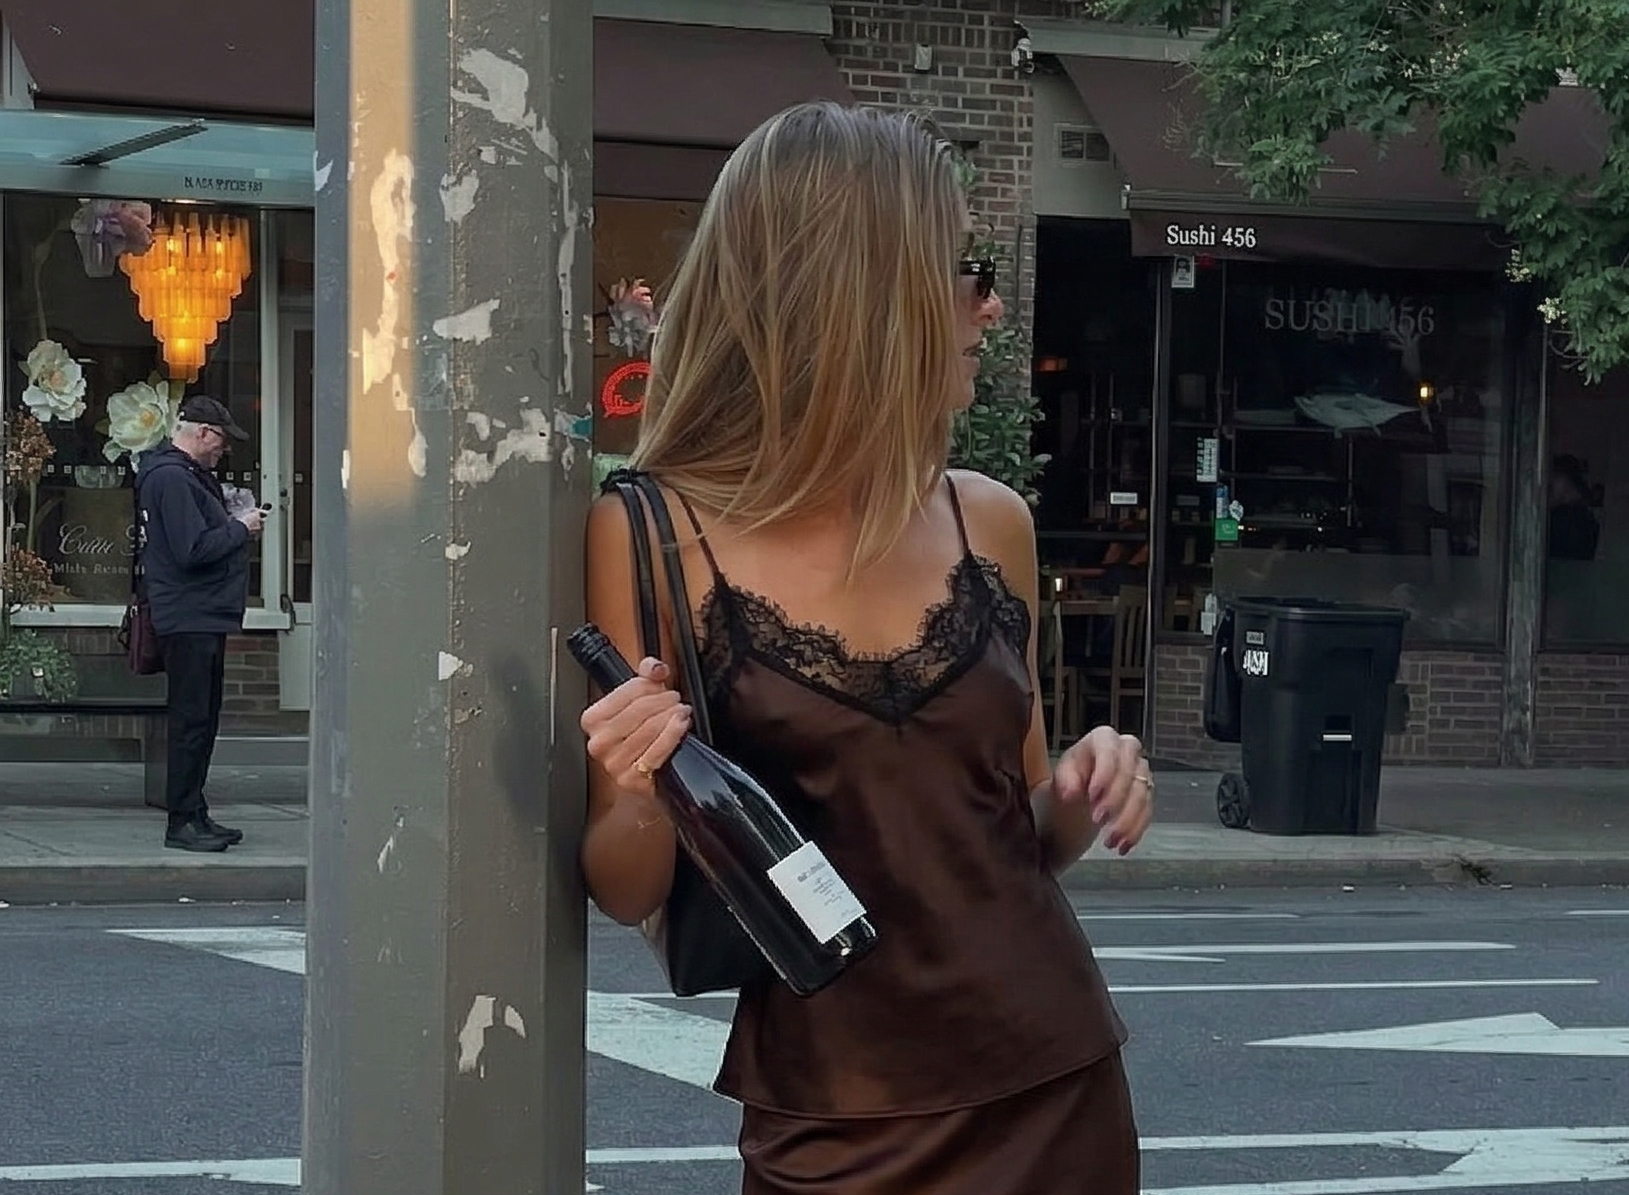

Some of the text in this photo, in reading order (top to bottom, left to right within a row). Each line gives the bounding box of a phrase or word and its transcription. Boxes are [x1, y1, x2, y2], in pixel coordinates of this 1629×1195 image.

[1166, 224, 1257, 248] Sushi 456
[1264, 299, 1372, 333] SUSHI
